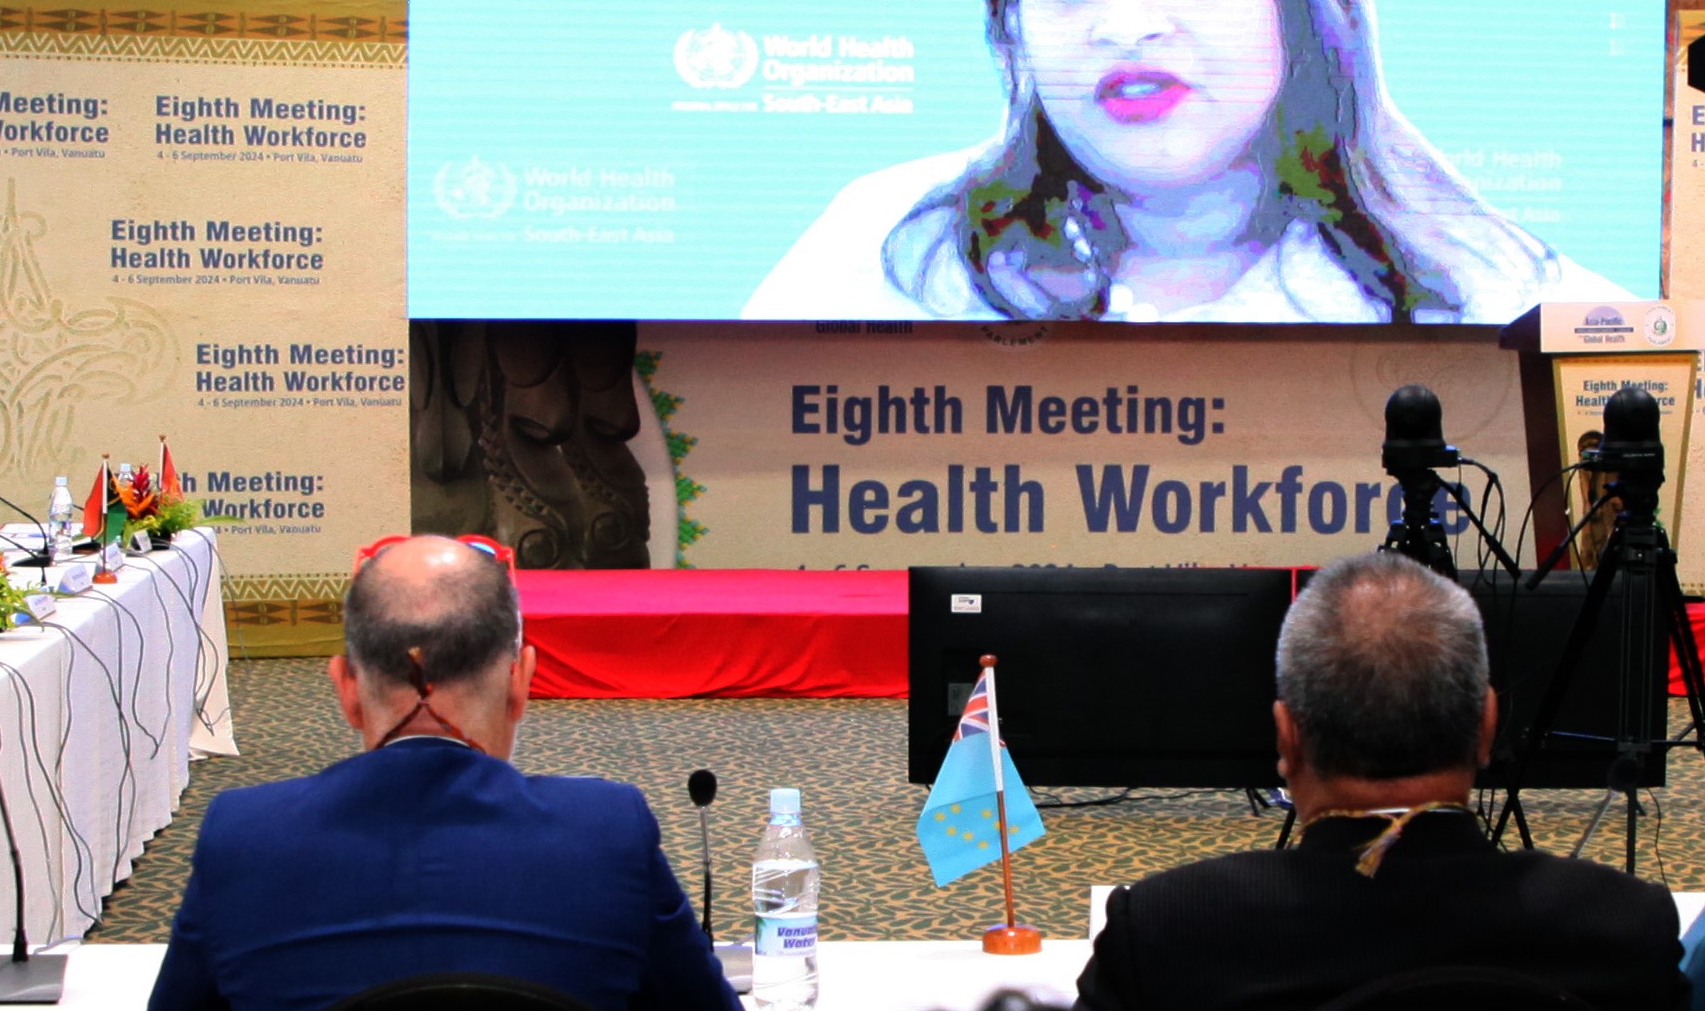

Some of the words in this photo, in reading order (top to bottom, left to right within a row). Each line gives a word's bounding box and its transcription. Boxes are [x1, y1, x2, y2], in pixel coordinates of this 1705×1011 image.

[762, 34, 832, 58] World
[838, 35, 915, 59] Health
[762, 59, 915, 87] Organization
[155, 95, 239, 121] Eighth
[250, 97, 366, 125] Meeting:
[870, 95, 914, 114] Asia
[155, 123, 234, 145] Health
[245, 125, 367, 148] Workforce
[524, 166, 592, 187] World
[599, 167, 676, 188] Health
[524, 190, 676, 216] Organization
[110, 219, 195, 245] Eighth
[205, 220, 323, 247] Meeting:
[110, 247, 190, 269] Health
[199, 249, 324, 270] Workforce
[196, 343, 279, 369] Eighth
[289, 344, 403, 369] Meeting:
[195, 371, 274, 392] Health
[283, 372, 405, 393] Workforce
[1583, 380, 1617, 393] Eighth
[222, 398, 276, 408] September
[279, 398, 303, 406] 2024
[313, 398, 334, 406] Port
[361, 398, 402, 406] Vanuatu
[1576, 396, 1609, 406] Healt
[792, 383, 963, 445] Eighth
[985, 384, 1226, 445] Meeting:
[207, 471, 323, 496] Meeting:
[202, 499, 325, 519] Workforce
[791, 464, 1045, 537] Health
